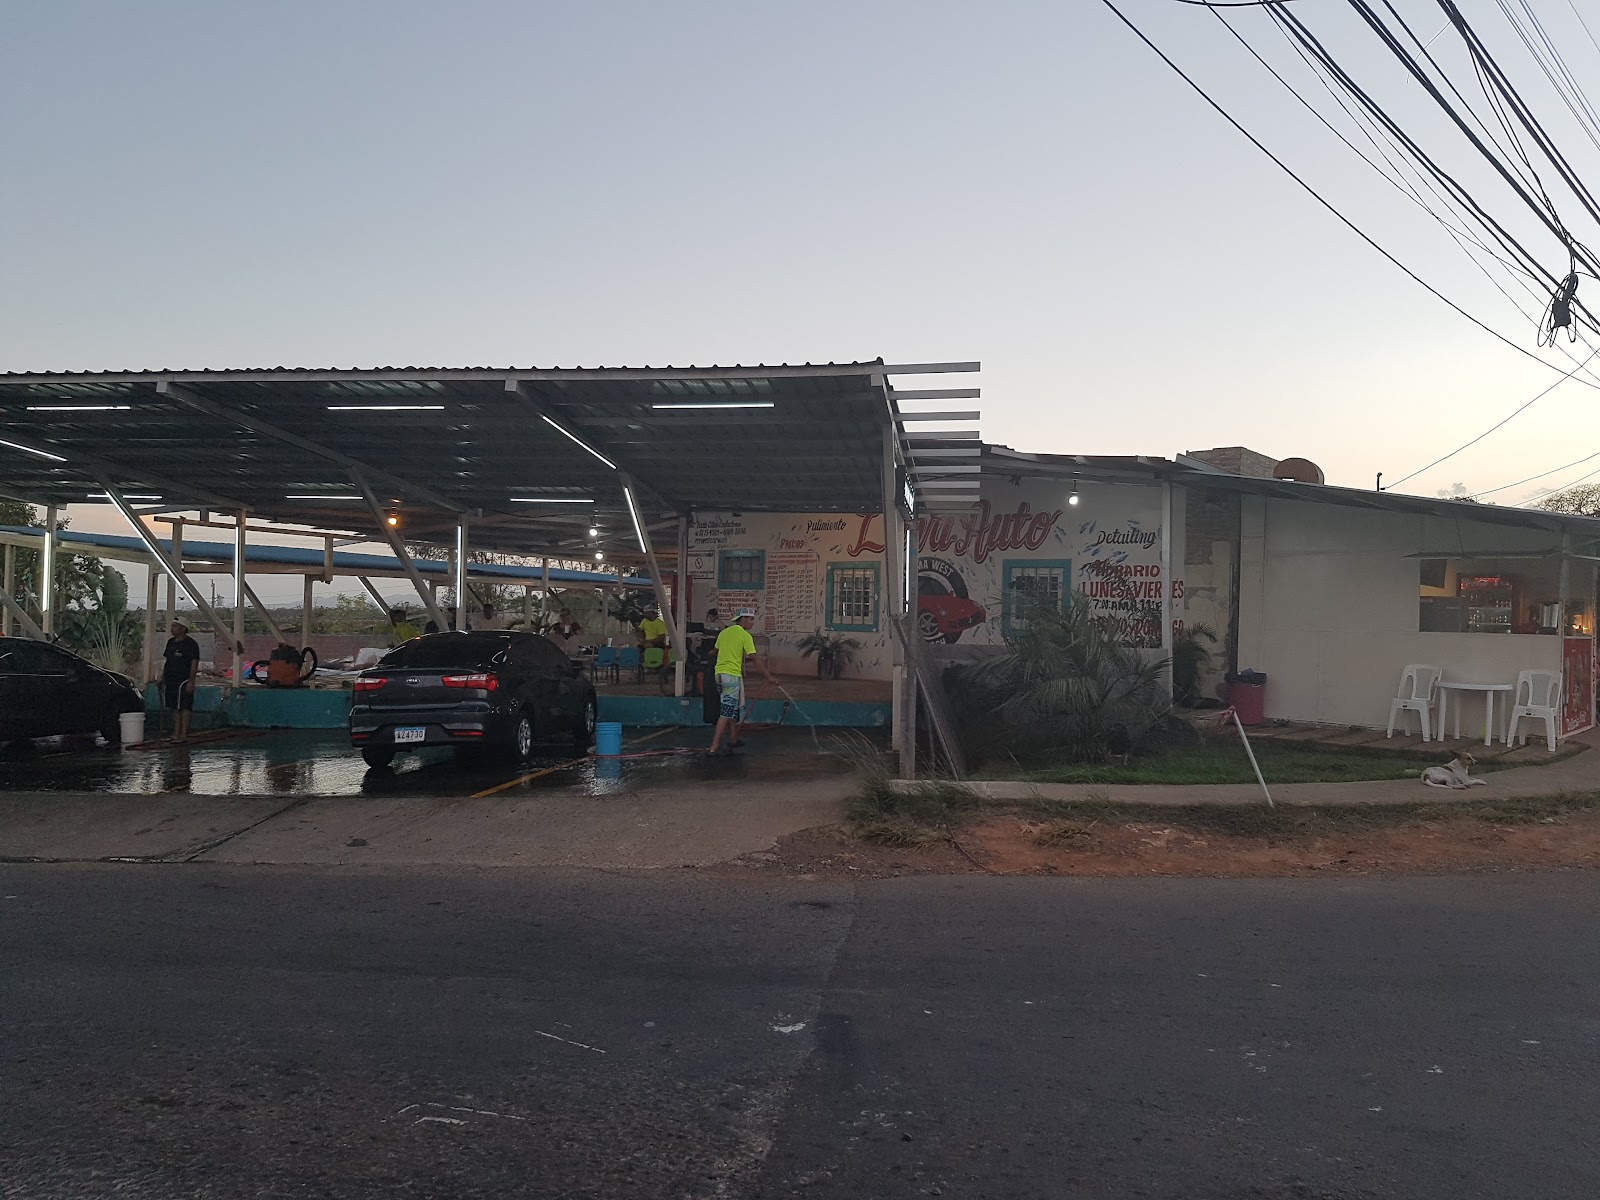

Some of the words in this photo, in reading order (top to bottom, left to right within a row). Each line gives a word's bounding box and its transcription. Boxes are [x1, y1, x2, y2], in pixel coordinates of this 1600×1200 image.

[953, 499, 1064, 564] Auto
[1092, 528, 1157, 549] Detailing
[931, 559, 954, 577] WEST
[1133, 580, 1184, 599] VIERES
